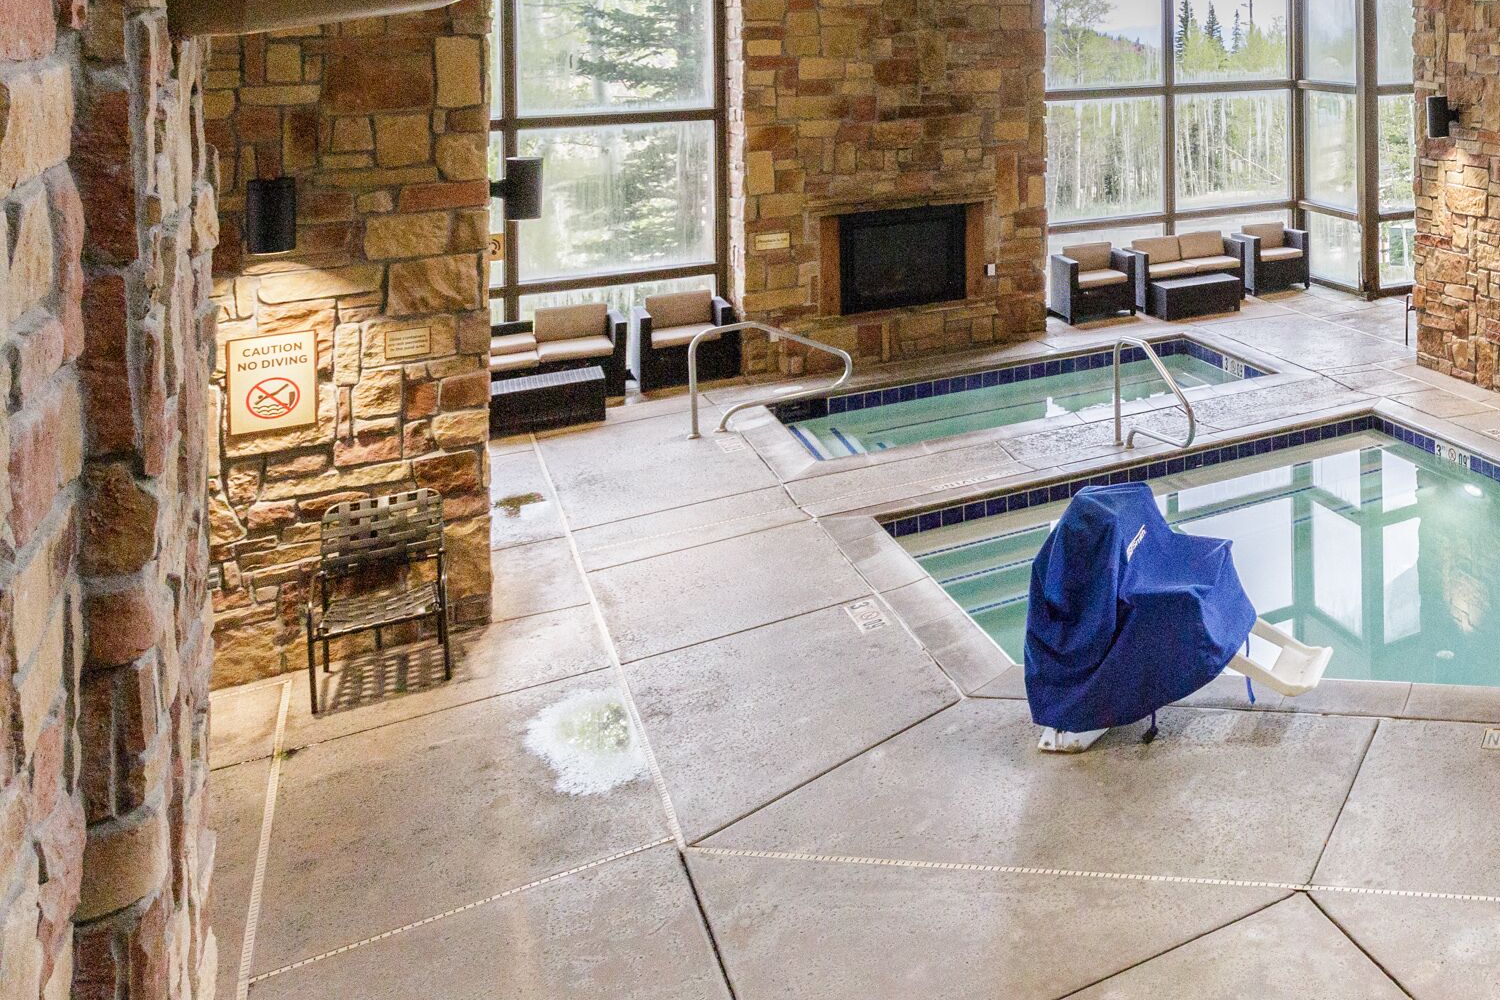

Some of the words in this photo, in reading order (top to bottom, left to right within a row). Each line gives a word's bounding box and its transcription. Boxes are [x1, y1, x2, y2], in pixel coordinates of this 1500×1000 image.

[242, 342, 303, 358] CAUTION
[237, 362, 258, 372] NO
[261, 354, 308, 369] DIVING
